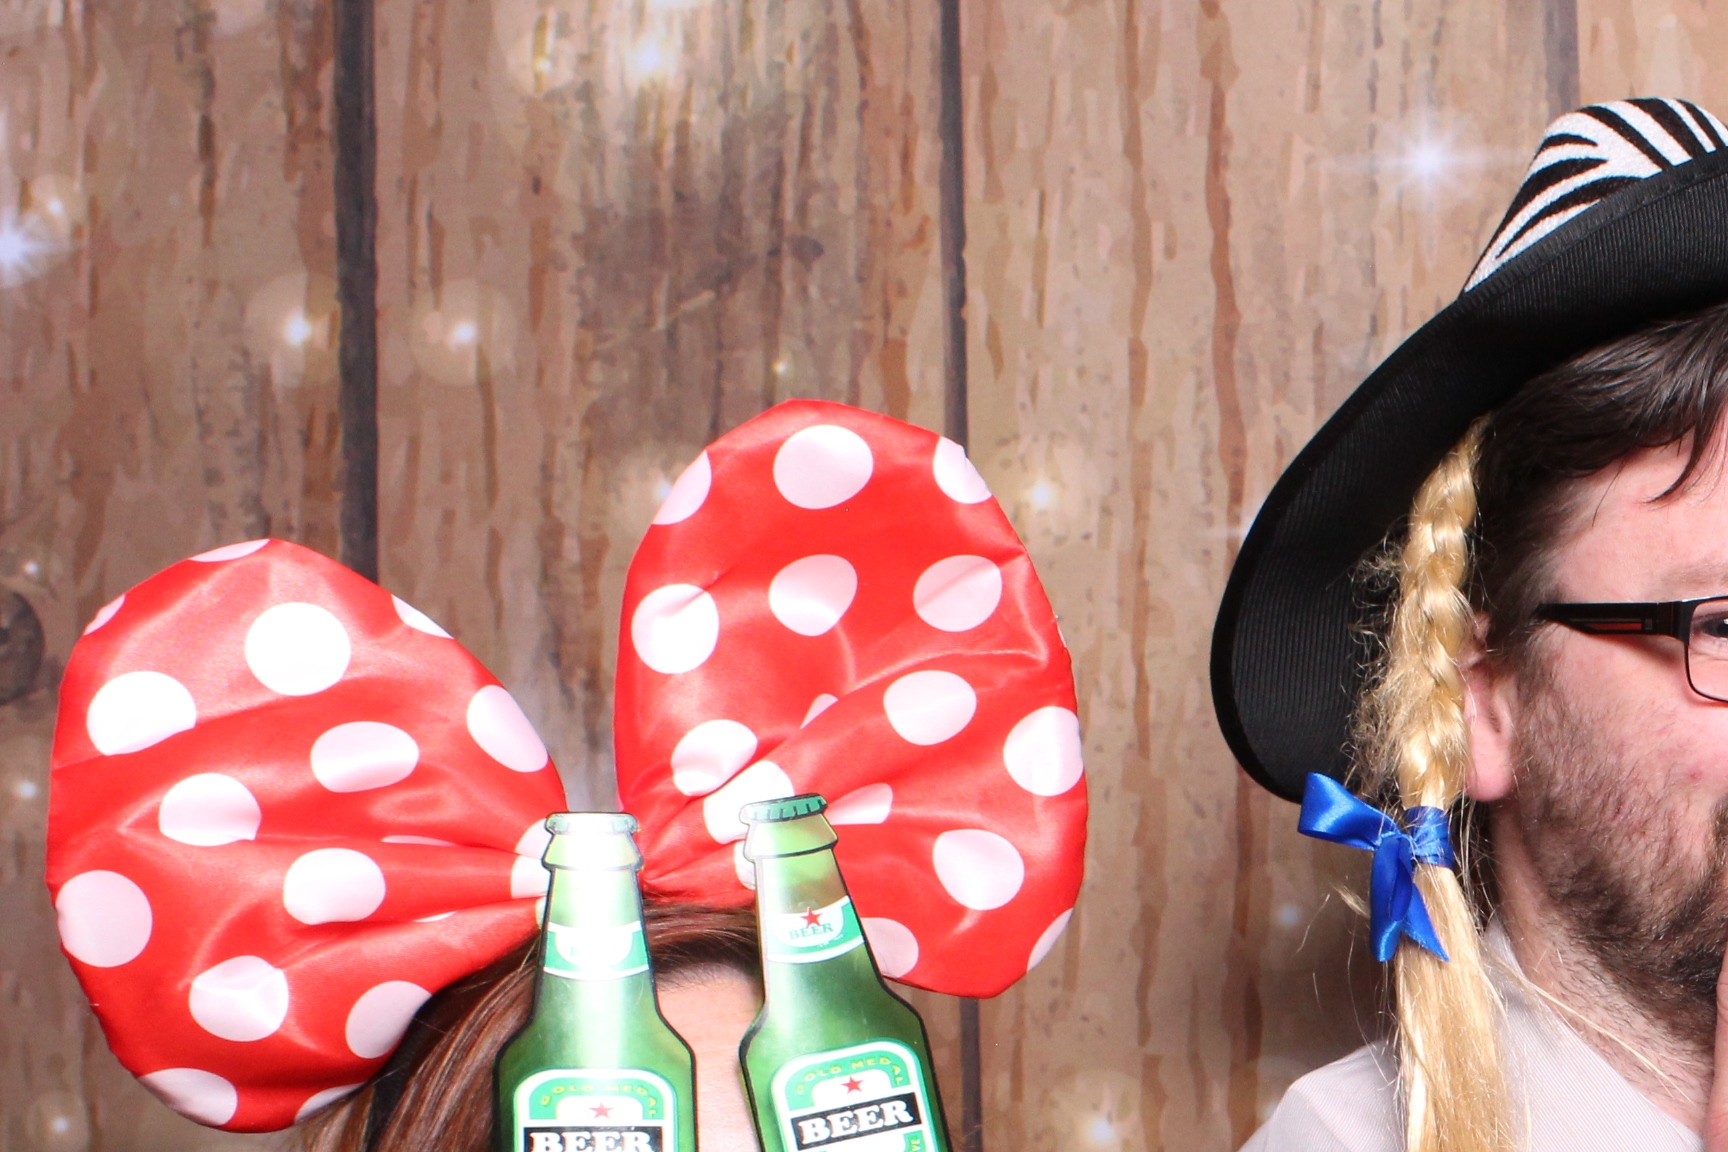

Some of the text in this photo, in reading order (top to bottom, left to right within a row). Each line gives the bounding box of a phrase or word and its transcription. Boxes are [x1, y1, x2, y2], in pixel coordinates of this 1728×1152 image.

[789, 923, 834, 940] BEER
[796, 1057, 904, 1095] GOLD MEDAL
[540, 1085, 657, 1117] GOLD MEDAL
[798, 1100, 914, 1144] BEER
